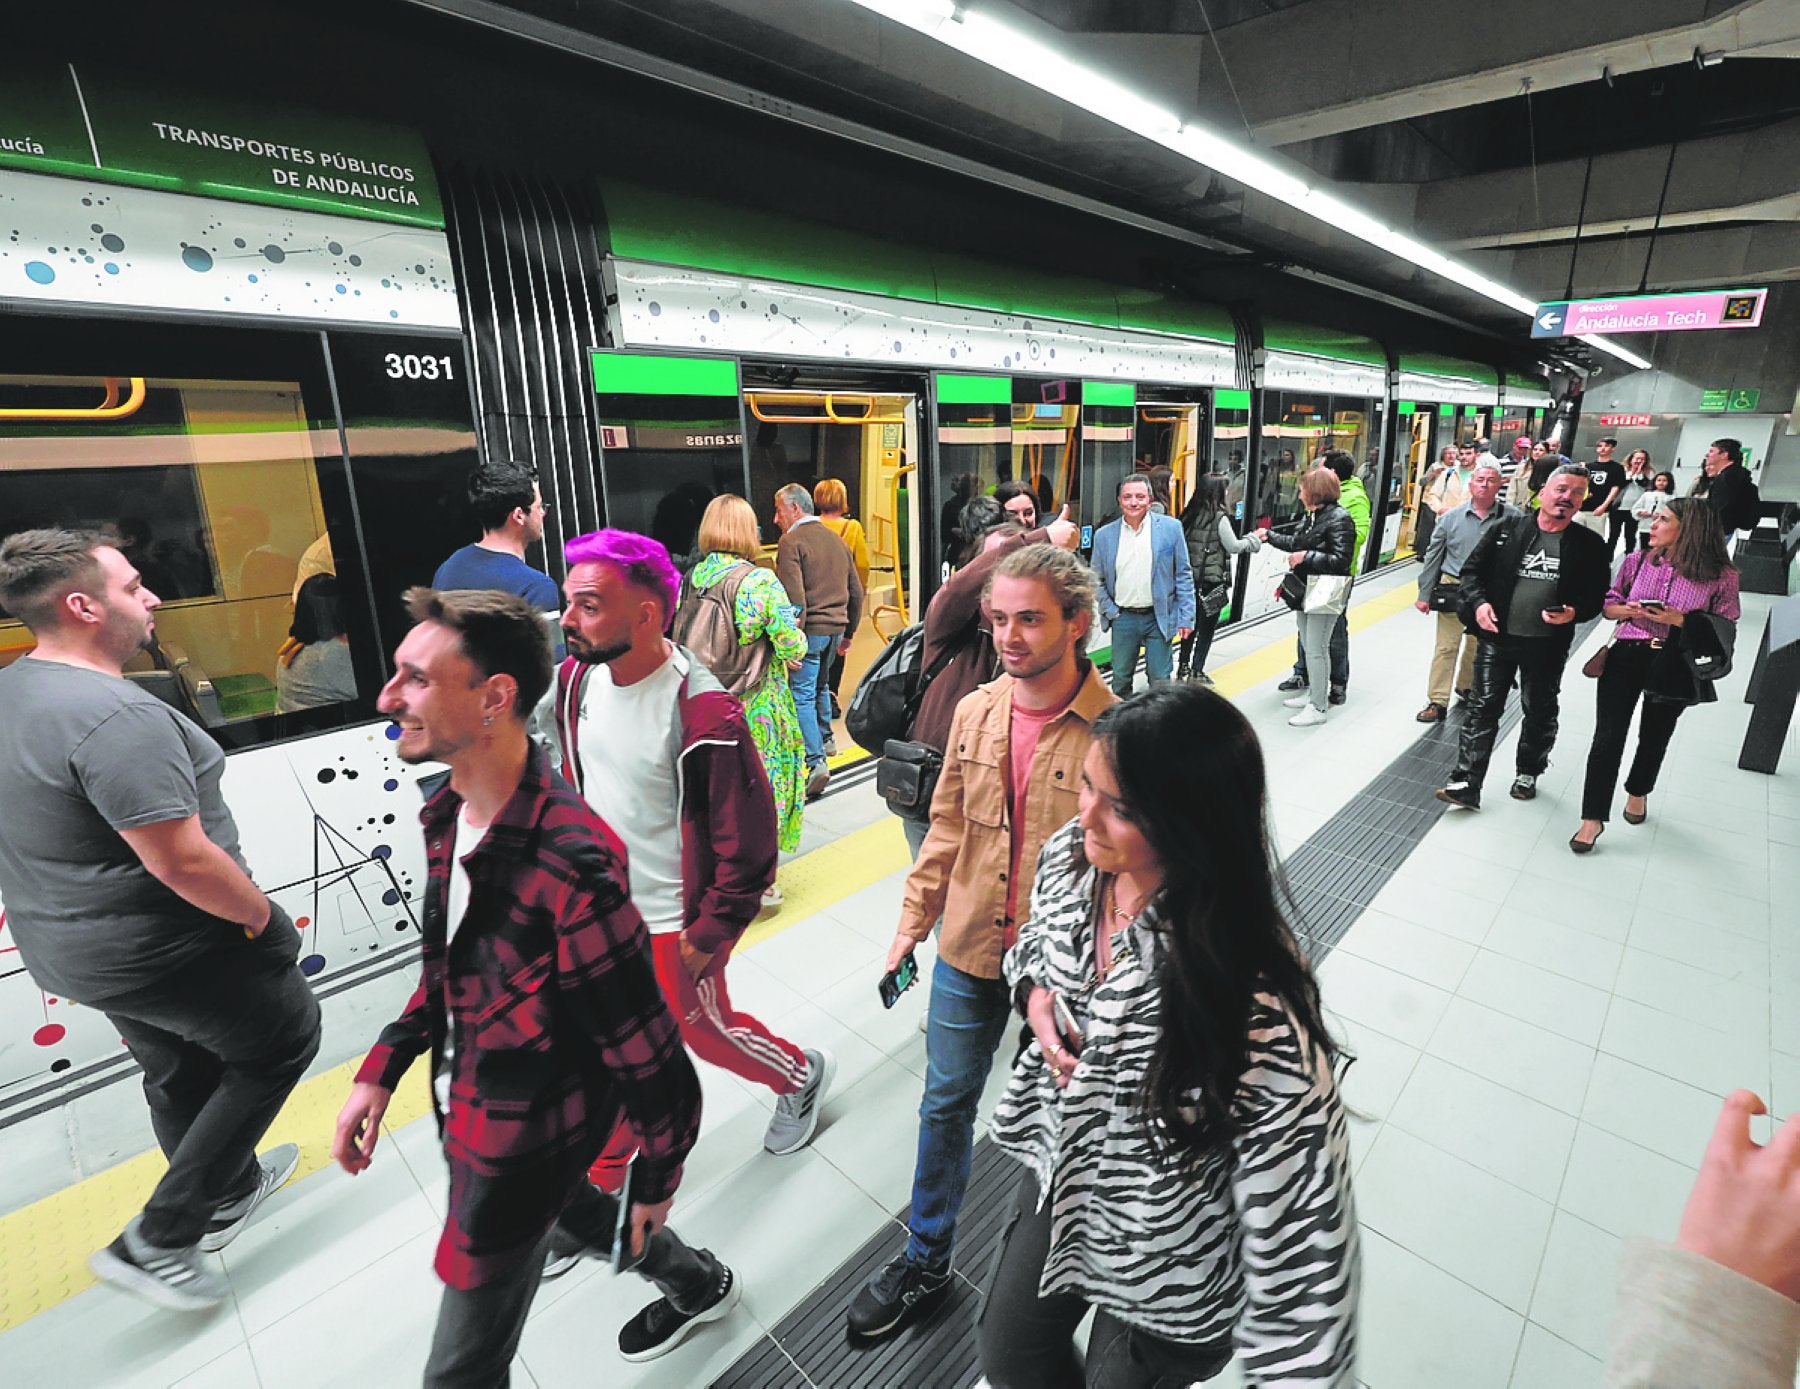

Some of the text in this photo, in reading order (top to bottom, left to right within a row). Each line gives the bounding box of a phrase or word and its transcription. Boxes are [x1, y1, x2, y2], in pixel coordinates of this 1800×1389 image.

[0, 136, 45, 155] ucía
[152, 122, 415, 182] TRANSPORTES PÚBLICOS
[272, 168, 419, 206] DE ANDALUCÍA
[1579, 303, 1618, 313] dirección
[1575, 310, 1707, 330] Andalucía Tech
[384, 353, 454, 380] 3031
